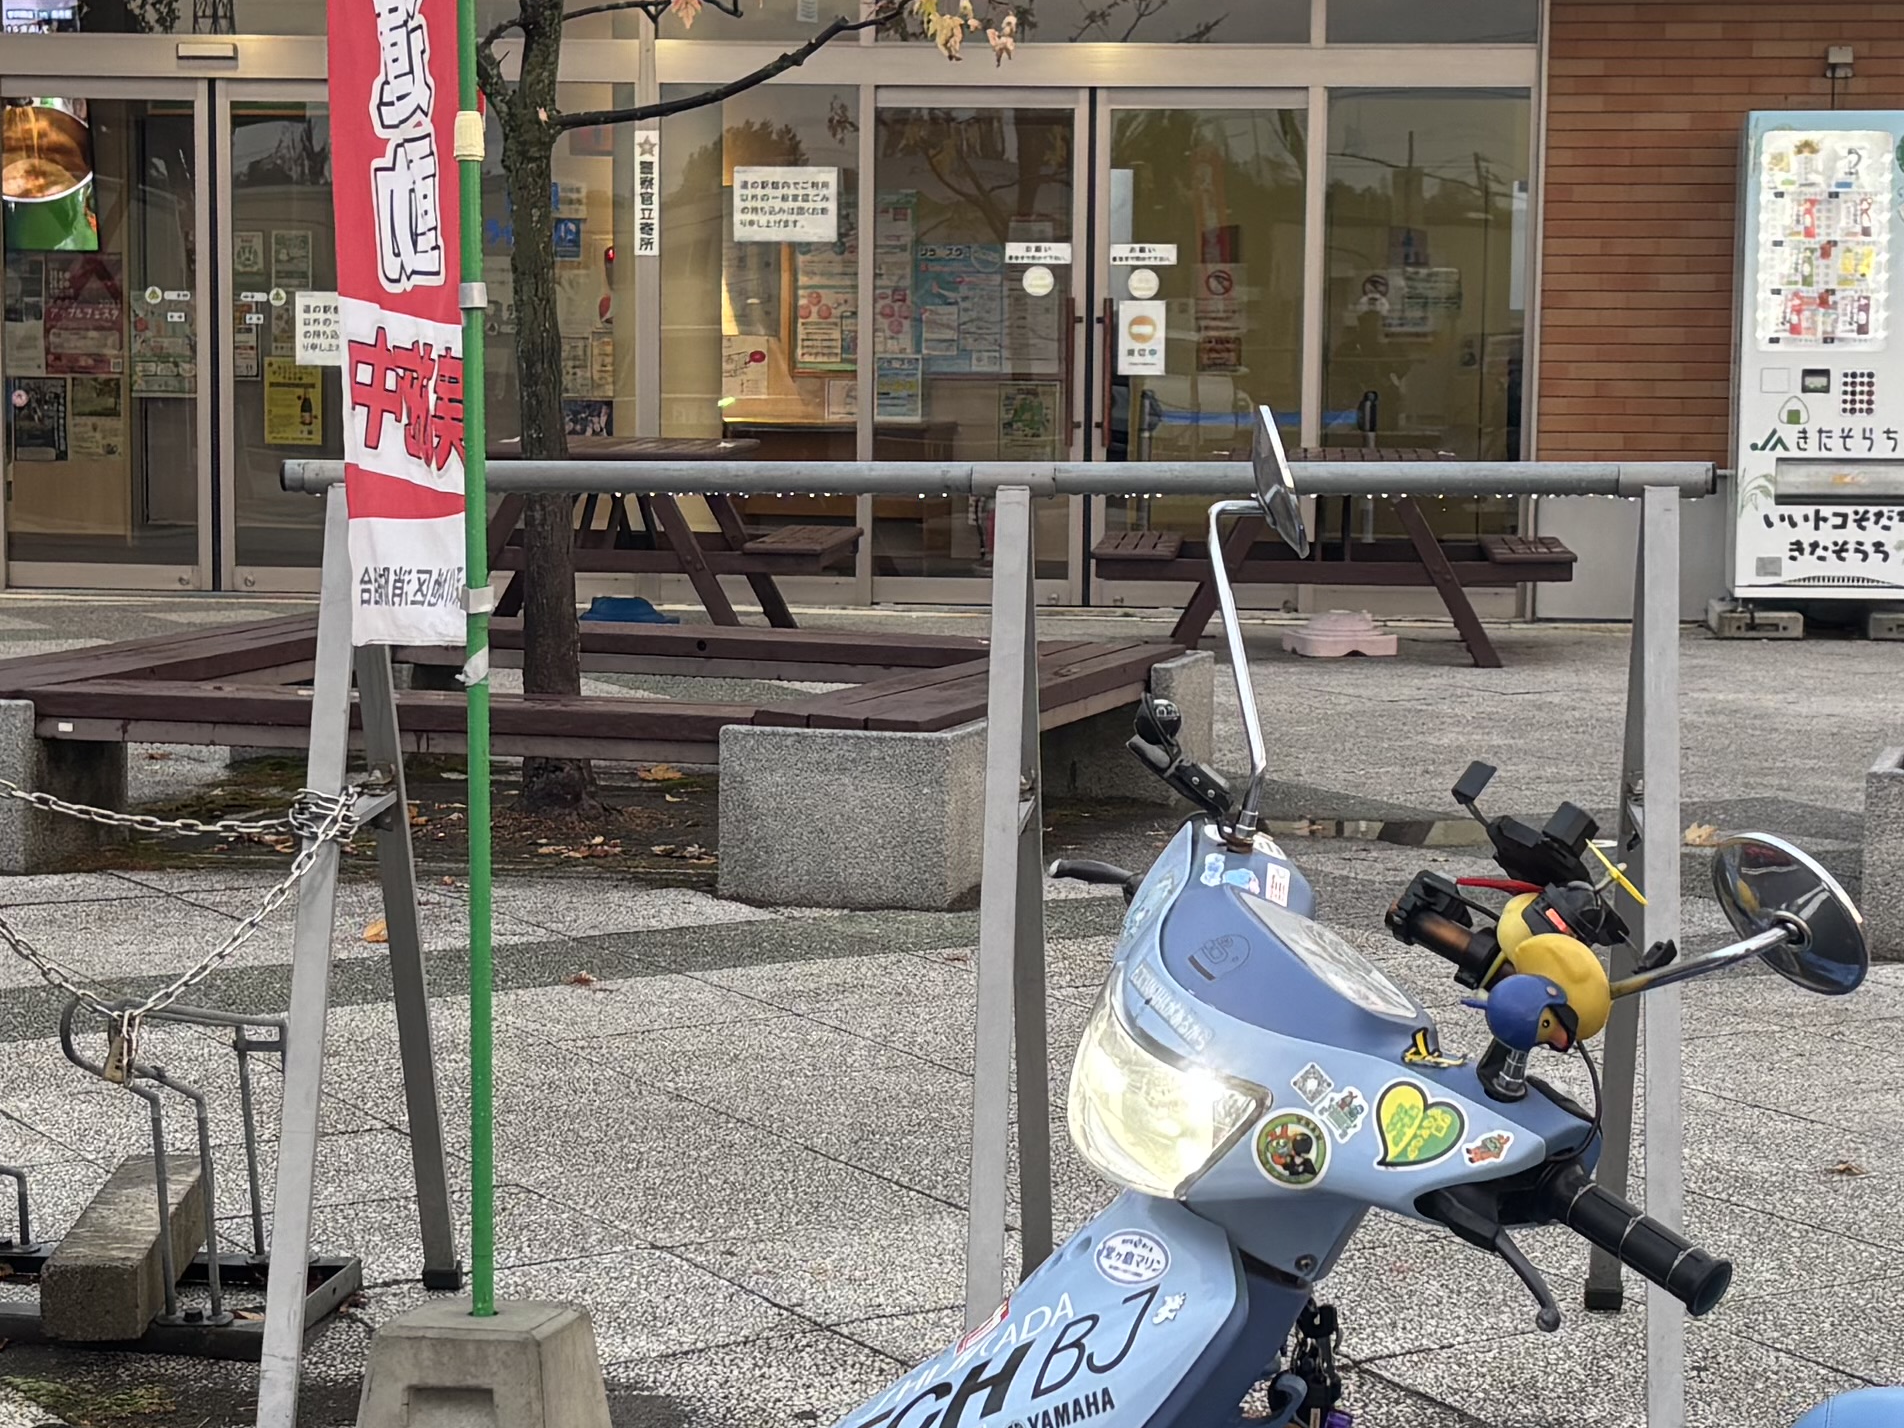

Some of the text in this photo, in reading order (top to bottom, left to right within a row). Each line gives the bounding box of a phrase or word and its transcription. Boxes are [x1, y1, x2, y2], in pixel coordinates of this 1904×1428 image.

[1796, 427, 1899, 452] きたそらち
[1031, 1284, 1160, 1400] BJ
